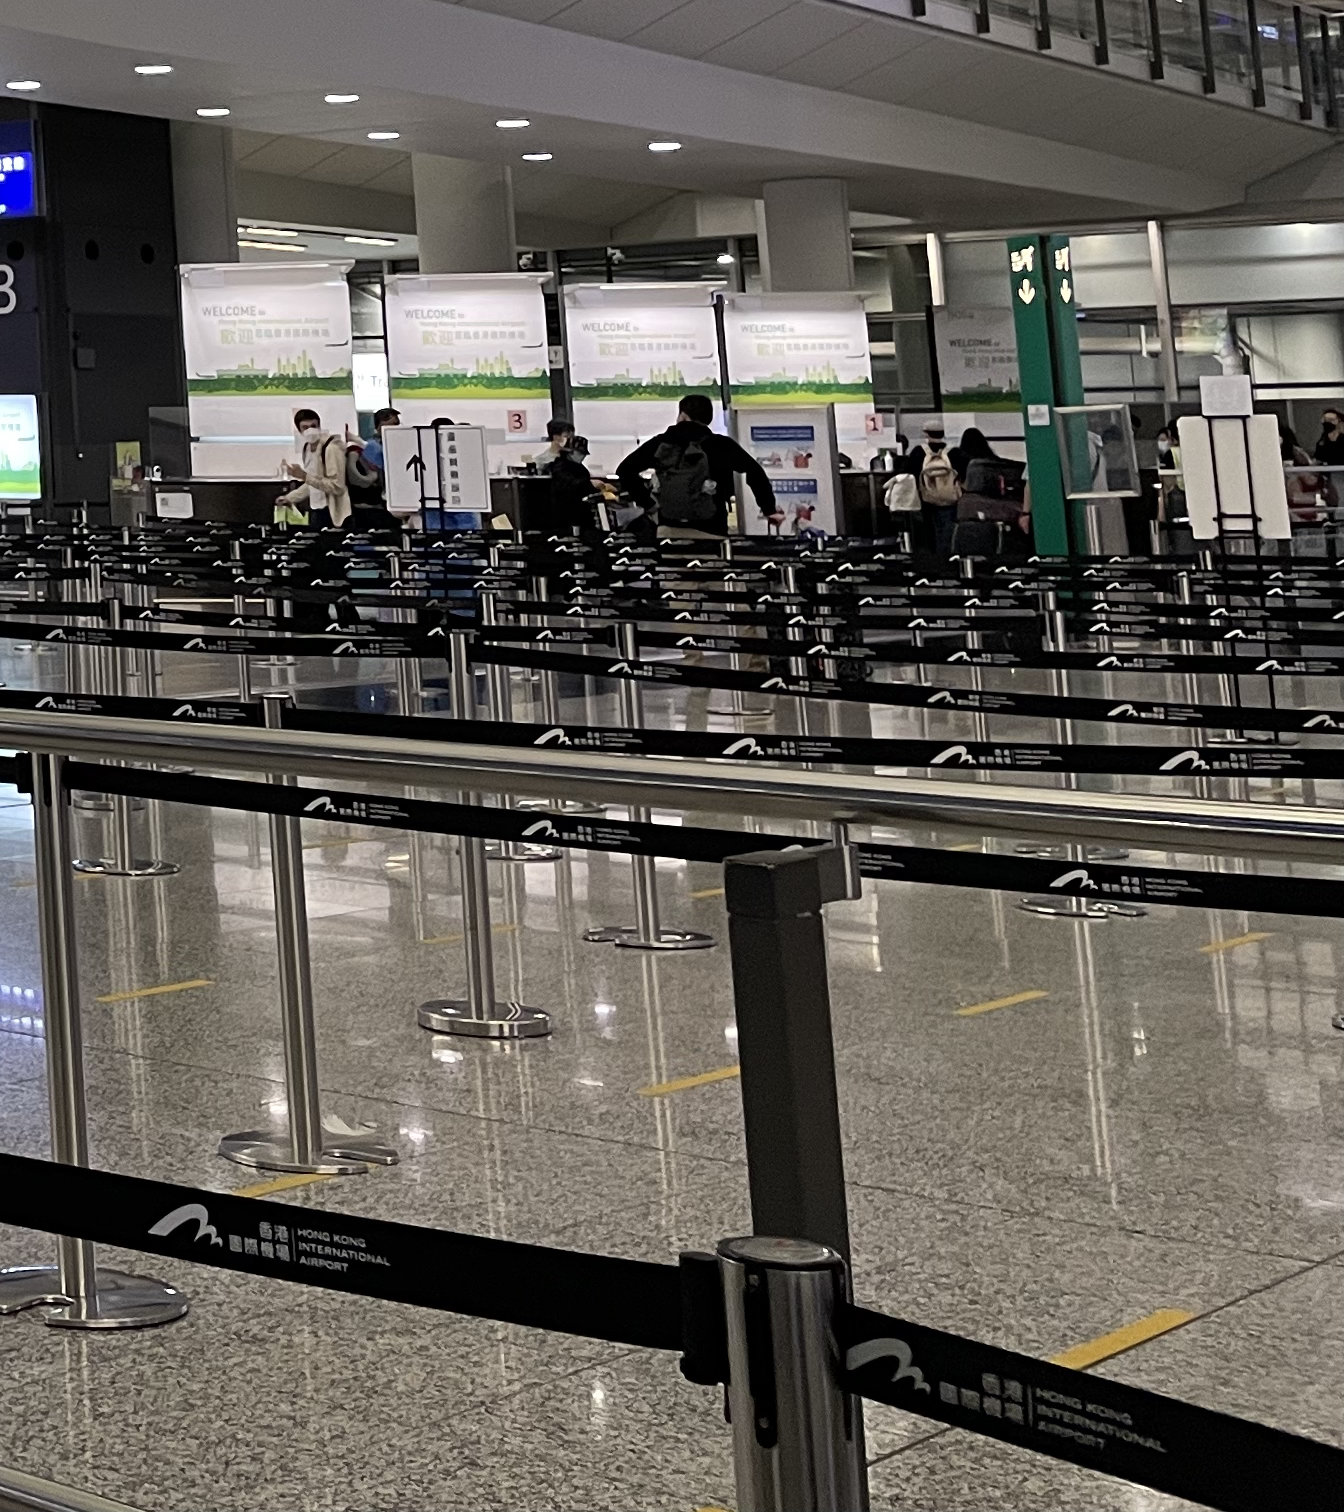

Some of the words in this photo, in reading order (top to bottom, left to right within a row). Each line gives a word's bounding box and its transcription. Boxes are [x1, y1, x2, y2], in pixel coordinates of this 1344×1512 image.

[202, 306, 256, 316] WELCOME
[404, 309, 456, 319] WELCOME
[581, 322, 630, 332] WELCOME
[740, 324, 786, 333] WELCOME
[949, 339, 993, 347] WELCOME
[512, 414, 522, 430] 3
[870, 417, 879, 431] 1
[297, 1228, 330, 1242] HONG
[333, 1234, 367, 1248] KONG
[298, 1241, 391, 1266] INTERNATIONAL
[299, 1256, 348, 1272] AIRPORT
[1036, 1387, 1083, 1410] HONG
[1086, 1403, 1133, 1426] KONG
[1037, 1404, 1167, 1453] INTERNATIONAL
